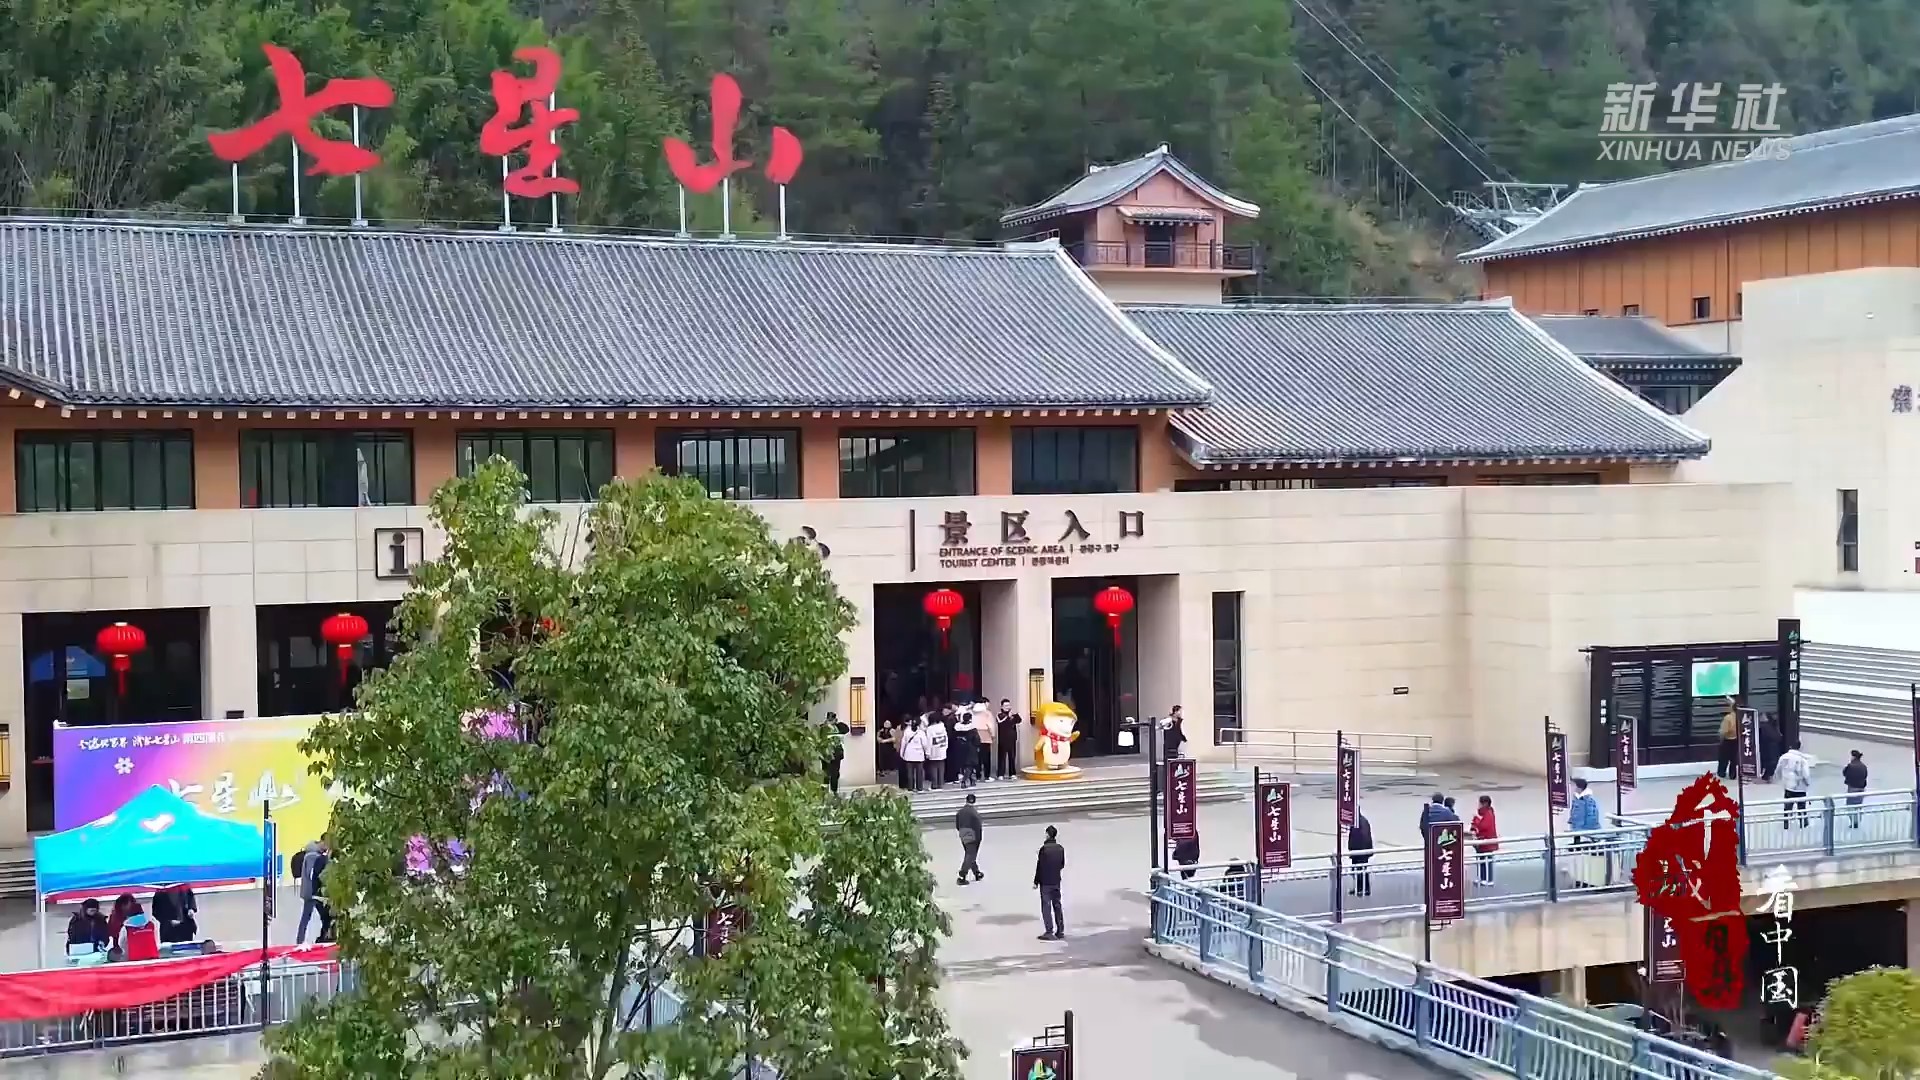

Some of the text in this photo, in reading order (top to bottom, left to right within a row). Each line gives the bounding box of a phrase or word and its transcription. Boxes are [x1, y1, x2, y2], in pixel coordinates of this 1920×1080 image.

[206, 42, 803, 199] 七星山
[938, 510, 1144, 545] 景区入口
[939, 545, 1065, 557] ENTRANCE OF SCENIC AREA
[940, 558, 1016, 568] TOURIST CENTER
[1174, 780, 1188, 815] 七星山
[1267, 806, 1281, 843] 七星山
[1438, 849, 1454, 890] 七星山
